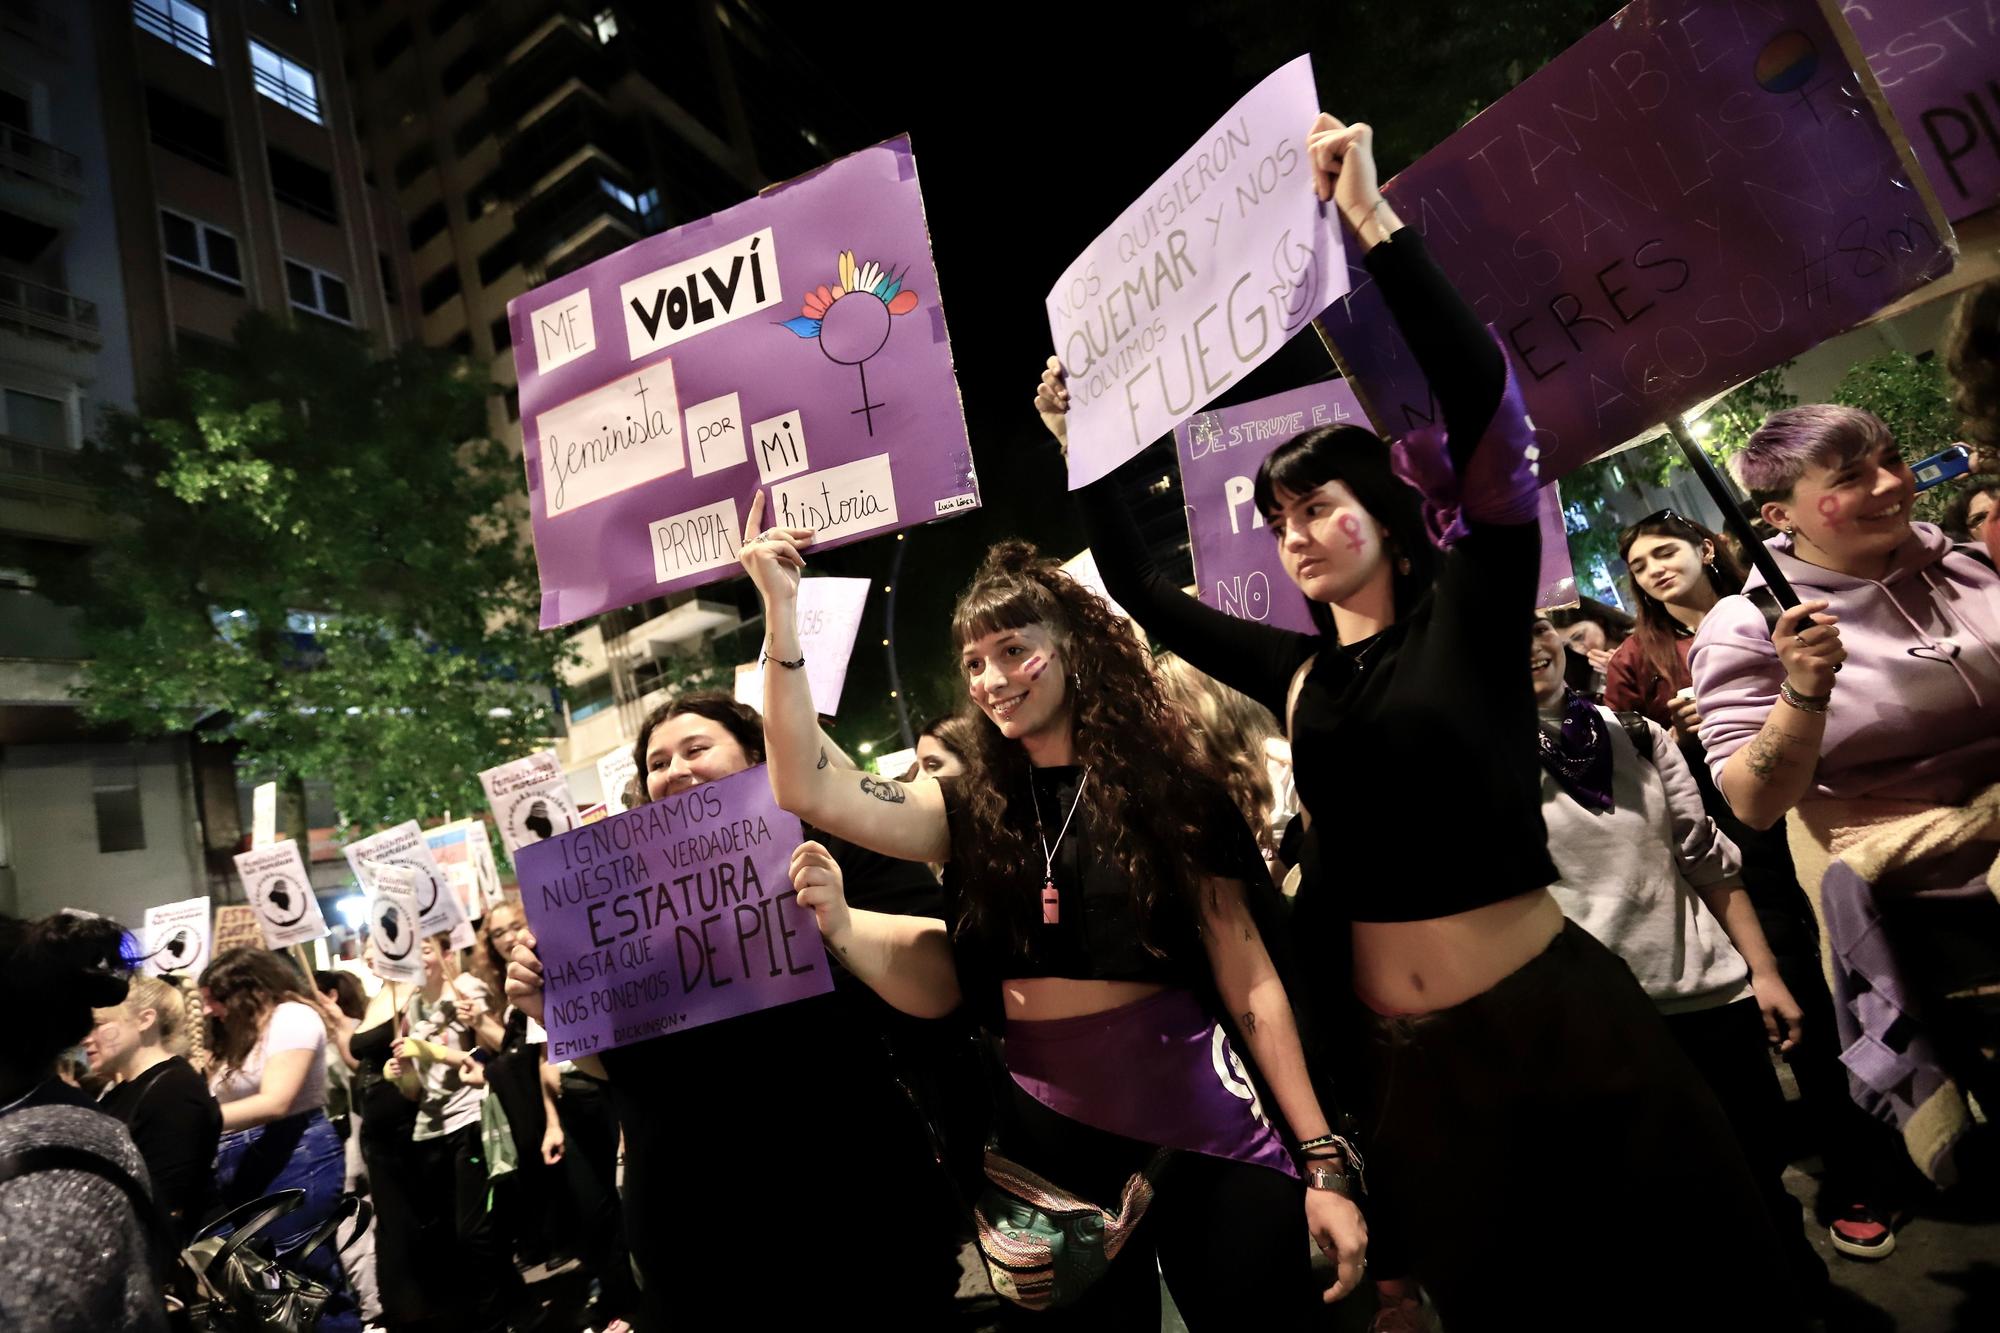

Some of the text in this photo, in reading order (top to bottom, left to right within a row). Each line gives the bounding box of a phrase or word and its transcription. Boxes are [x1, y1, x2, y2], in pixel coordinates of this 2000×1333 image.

[1655, 93, 1784, 196] LAS
[1057, 115, 1250, 319] NOS QUISIERON
[1066, 138, 1299, 379] QUEMAR Y NOS
[540, 237, 766, 360] ME VOLVÍ
[1075, 318, 1167, 407] VOLVIMOS
[550, 377, 672, 510] feminista
[1187, 403, 1350, 460] DESTRUYE EL
[659, 481, 888, 571] PROPIA historia
[1217, 570, 1270, 620] NO
[542, 816, 771, 911] NUESTRA VERDADERA
[561, 786, 722, 869] IGNORAMOS
[587, 856, 764, 948] ESTATURA
[675, 890, 814, 994] DE PIE
[549, 936, 655, 990] HASTA QUE
[553, 970, 670, 1028] NOS PONEMOS
[554, 1014, 678, 1056] EMILY DICKINSON
